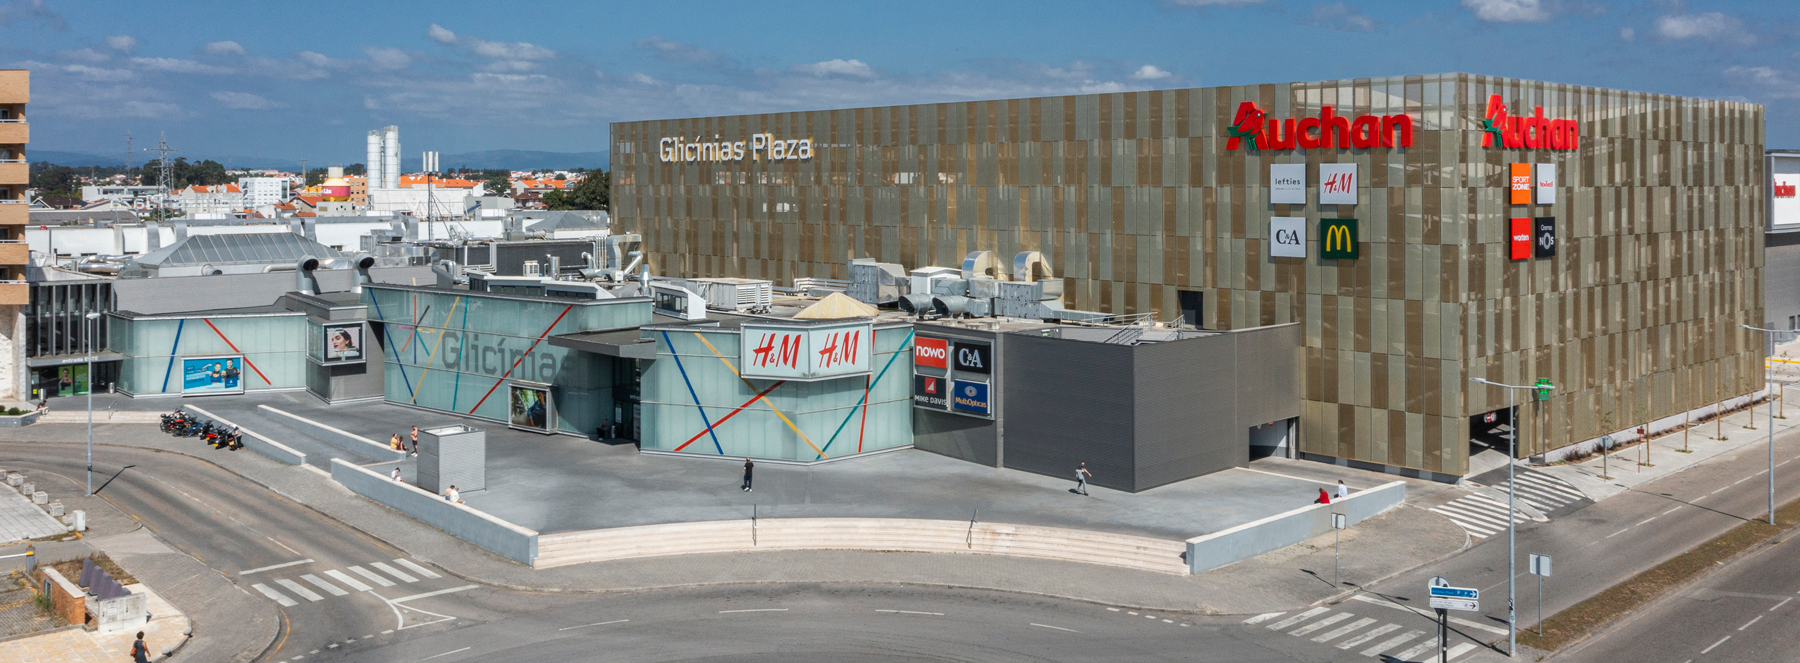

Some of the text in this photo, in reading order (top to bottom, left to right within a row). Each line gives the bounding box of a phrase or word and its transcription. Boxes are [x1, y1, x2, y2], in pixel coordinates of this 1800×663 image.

[1225, 101, 1412, 150] Auchan
[1481, 93, 1578, 150] Auchan
[659, 132, 811, 162] Glicínias Plaza
[1275, 178, 1301, 186] lefties
[1323, 172, 1353, 194] H&M
[1275, 229, 1301, 245] C&A
[1539, 232, 1554, 250] NOS
[752, 332, 802, 370] H&M
[818, 329, 860, 369] H&M
[916, 345, 946, 359] nowo
[958, 347, 983, 368] C&A
